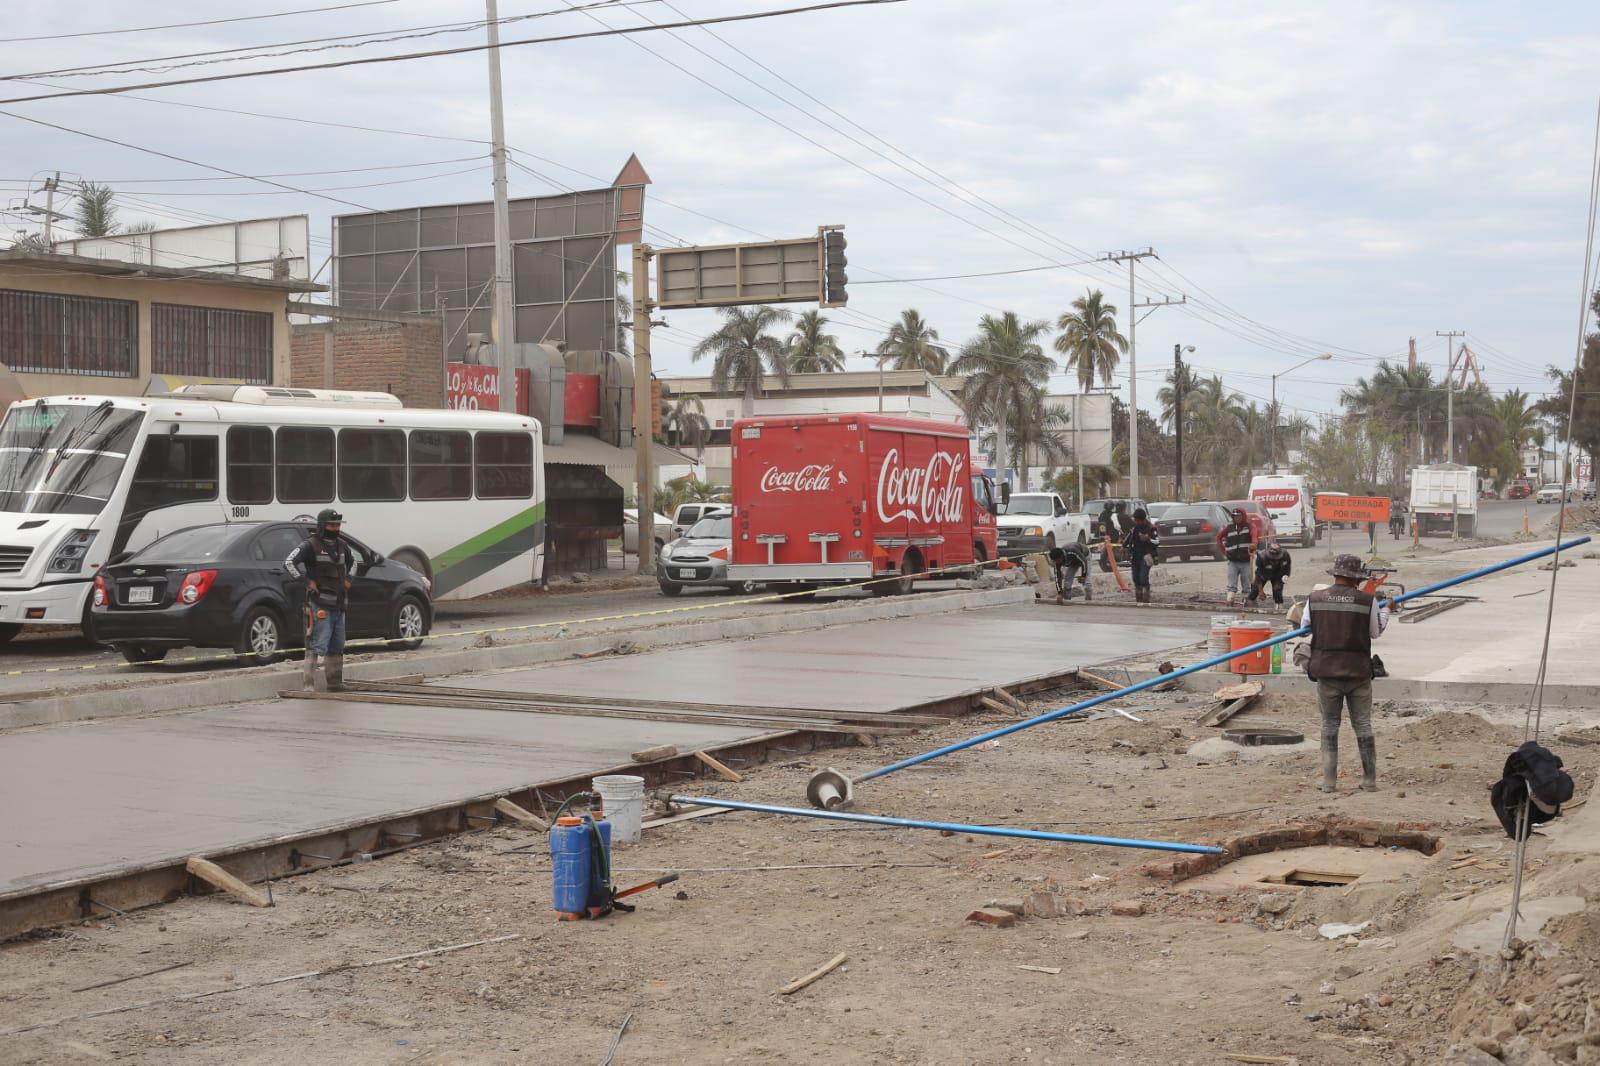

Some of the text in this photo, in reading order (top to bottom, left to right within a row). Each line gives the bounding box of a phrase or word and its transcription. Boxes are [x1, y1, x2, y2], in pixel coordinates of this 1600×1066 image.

[761, 465, 833, 492] Coca-Cola
[877, 448, 966, 523] Coca-Cola
[1254, 493, 1296, 502] estafeta
[1347, 500, 1383, 508] CERRADA
[232, 506, 249, 517] 1800
[1350, 511, 1371, 519] OBRA
